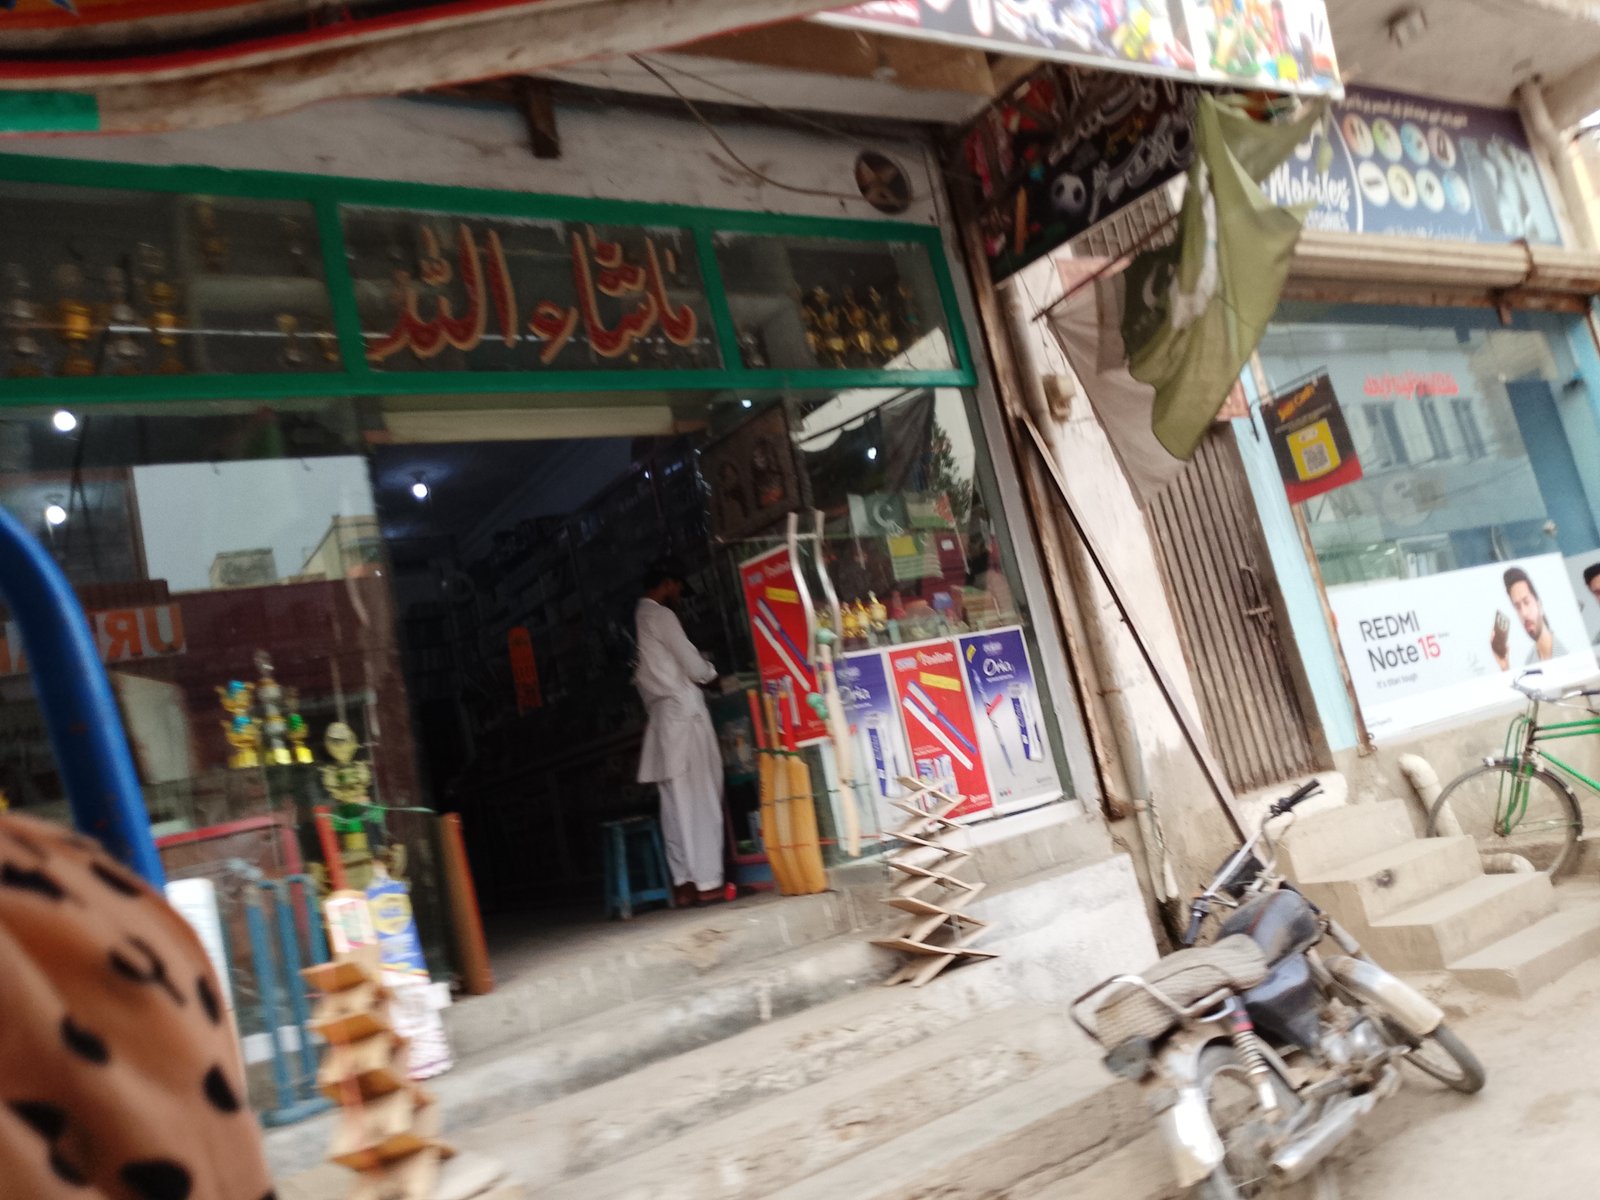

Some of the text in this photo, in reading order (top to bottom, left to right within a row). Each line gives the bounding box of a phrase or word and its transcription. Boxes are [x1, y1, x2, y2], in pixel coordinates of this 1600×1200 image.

[1359, 610, 1421, 642] REDMI
[1367, 634, 1441, 672] Note 15
